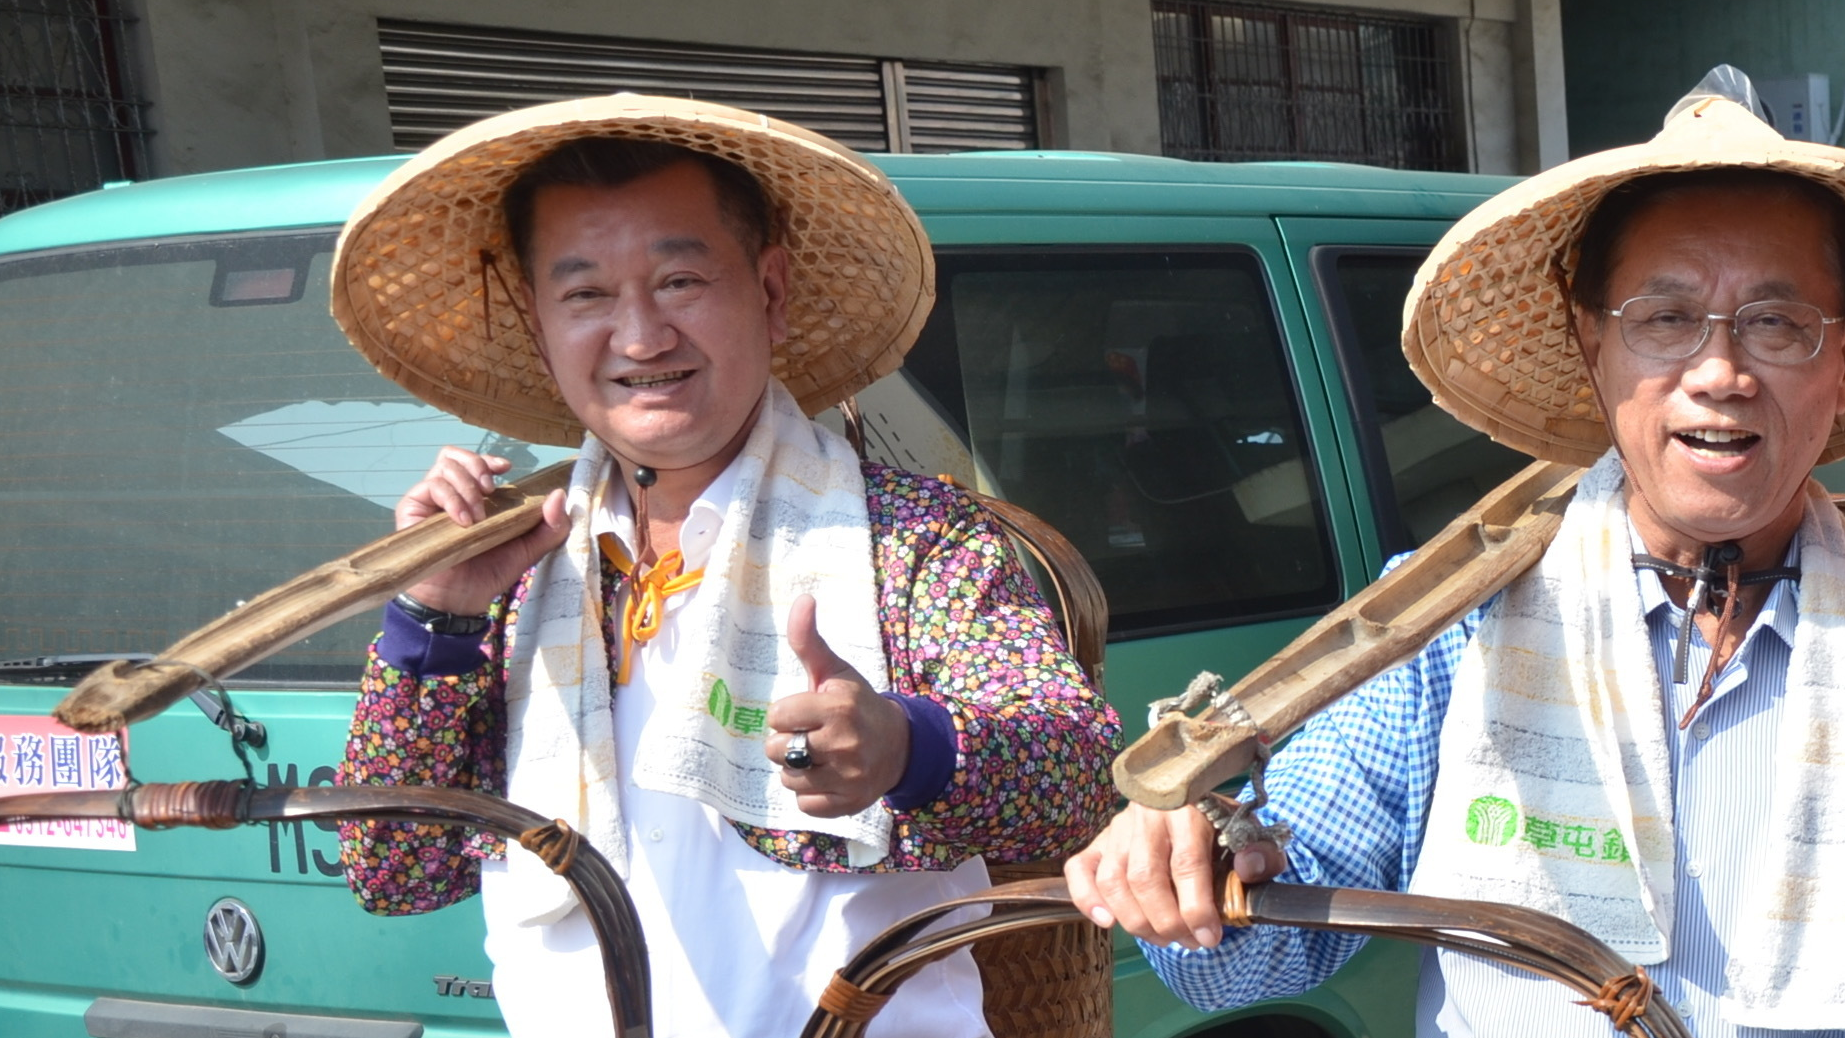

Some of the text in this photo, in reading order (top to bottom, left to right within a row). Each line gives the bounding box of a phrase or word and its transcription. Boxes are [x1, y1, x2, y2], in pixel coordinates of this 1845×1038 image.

[0, 735, 122, 789] 務團隊
[433, 975, 495, 999] Tra
